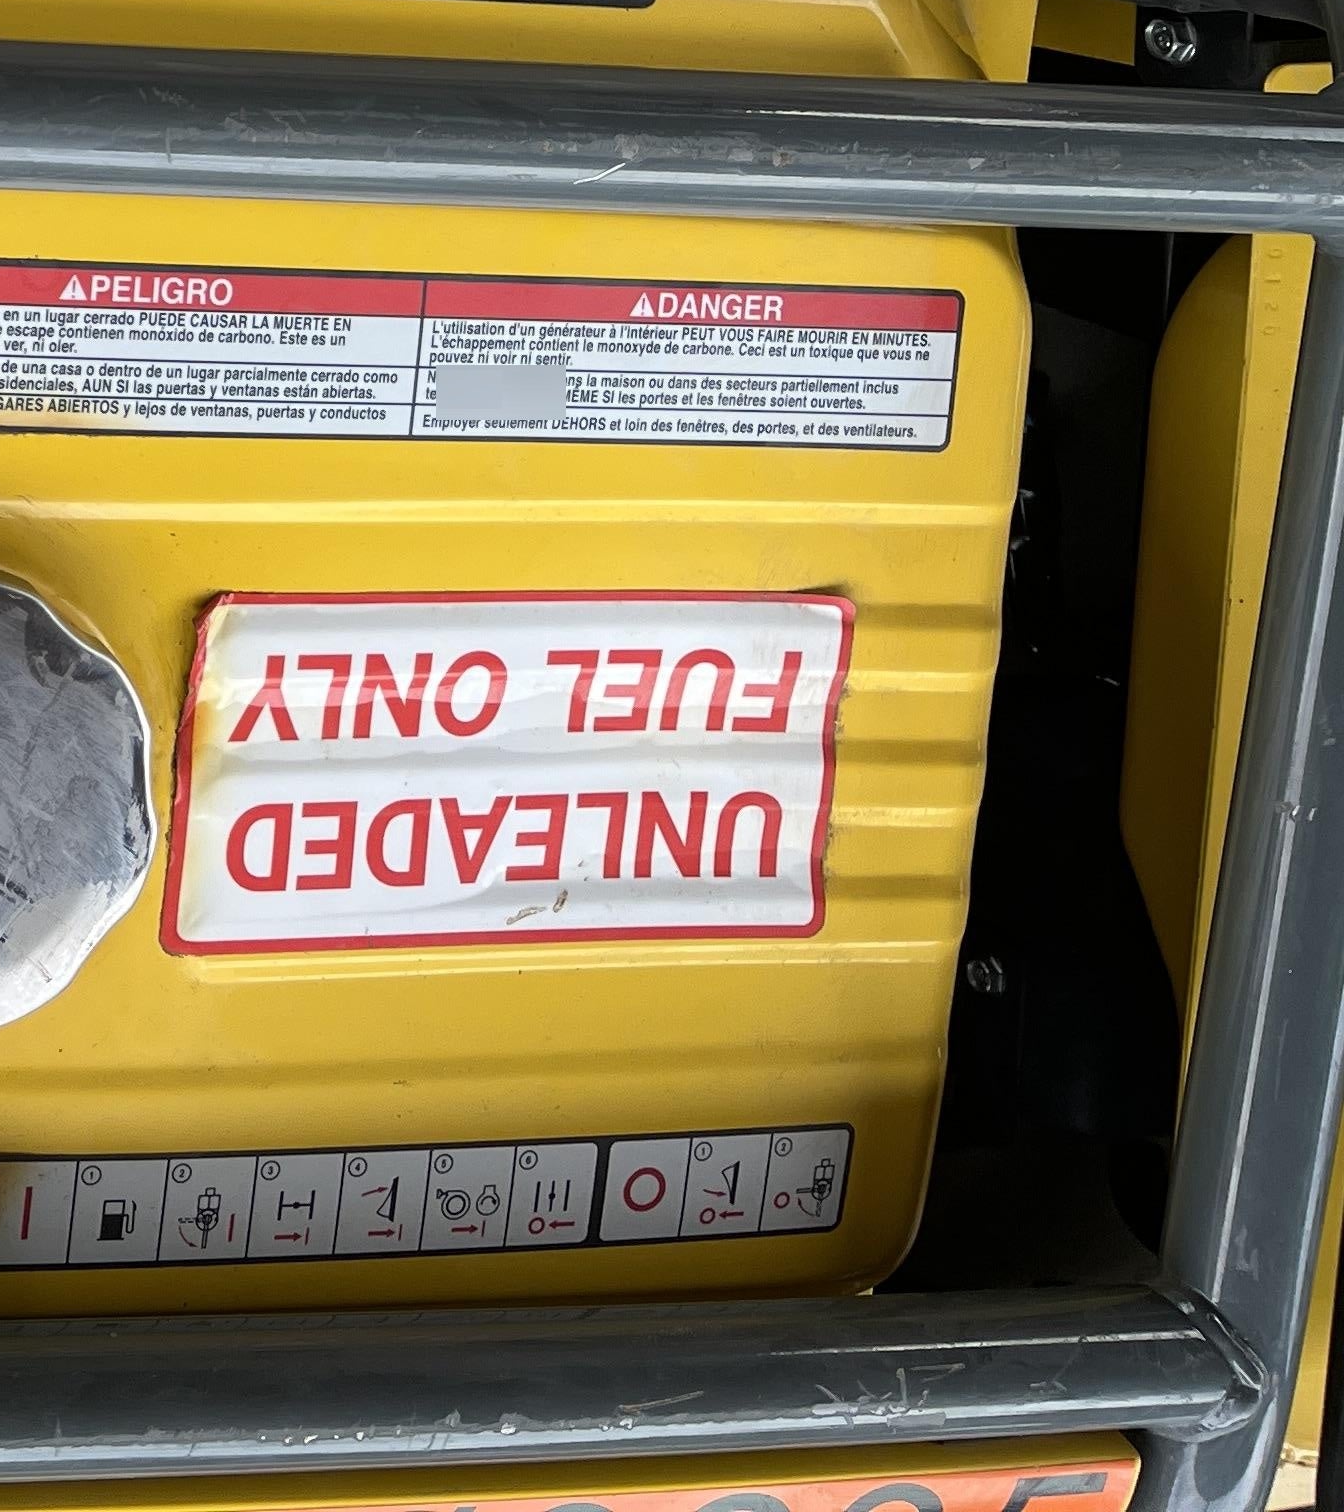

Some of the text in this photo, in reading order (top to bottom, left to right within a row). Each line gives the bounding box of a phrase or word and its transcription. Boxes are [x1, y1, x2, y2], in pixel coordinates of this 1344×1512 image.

[90, 275, 233, 306] PELIGRO
[3, 310, 19, 320] en
[23, 311, 41, 321] un
[44, 308, 80, 325] lugar
[83, 310, 135, 324] cerrado
[139, 311, 186, 325] PUEDE
[190, 313, 248, 327] CAUSAR
[251, 315, 270, 328] LA
[273, 316, 329, 330] MUERTE
[333, 318, 351, 331] EN
[658, 292, 783, 322] DANGER
[586, 374, 597, 387] la
[600, 375, 645, 388] maison
[648, 379, 664, 389] ou
[667, 376, 697, 389] dans
[700, 377, 722, 390] des
[725, 378, 778, 391] secteurs
[780, 379, 859, 396] partiellement
[862, 381, 899, 394] inclus
[601, 391, 614, 404] SI
[617, 391, 636, 404] les
[638, 392, 678, 408] portes
[681, 393, 693, 405] et
[696, 393, 714, 406] les
[717, 393, 766, 407] fenêtres
[769, 394, 807, 408] soient
[809, 395, 866, 409] ouvertes.
[609, 419, 621, 432] et
[624, 419, 647, 432] loin
[650, 420, 673, 433] des
[675, 420, 728, 437] fenêtres,
[731, 421, 754, 434] des
[756, 422, 799, 439] portes,
[802, 423, 814, 436] et
[817, 423, 840, 436] des
[842, 424, 917, 438] ventilateurs.
[228, 649, 803, 742] FUEL ONLY
[225, 791, 784, 892] UNLEADED
